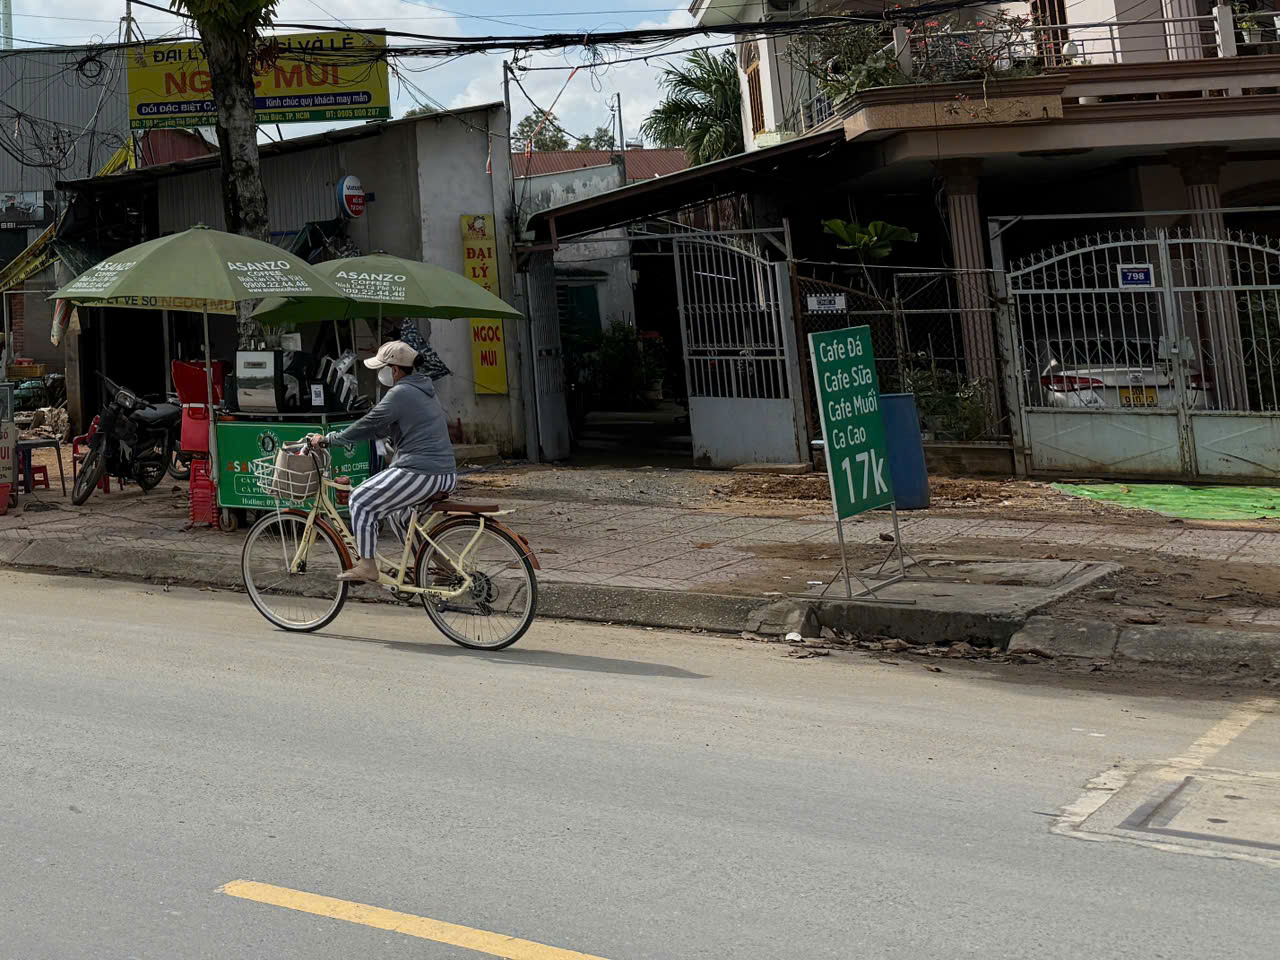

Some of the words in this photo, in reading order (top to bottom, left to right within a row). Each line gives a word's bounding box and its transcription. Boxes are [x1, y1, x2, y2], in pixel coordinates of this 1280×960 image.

[314, 95, 335, 105] khách
[336, 95, 351, 104] may
[466, 248, 492, 262] ĐẠI
[227, 260, 290, 271] ASANZO
[336, 271, 406, 282] ASANZO
[1126, 272, 1145, 280] 798
[473, 325, 500, 342] NGỌC
[820, 342, 846, 362] Cafe
[847, 336, 863, 357] Đá
[824, 371, 850, 392] Cafe
[851, 364, 872, 386] Sữa
[828, 401, 852, 422] Cafe
[853, 390, 878, 415] Muối
[832, 429, 846, 450] Ca
[847, 424, 866, 445] Cao
[841, 449, 888, 504] 17k
